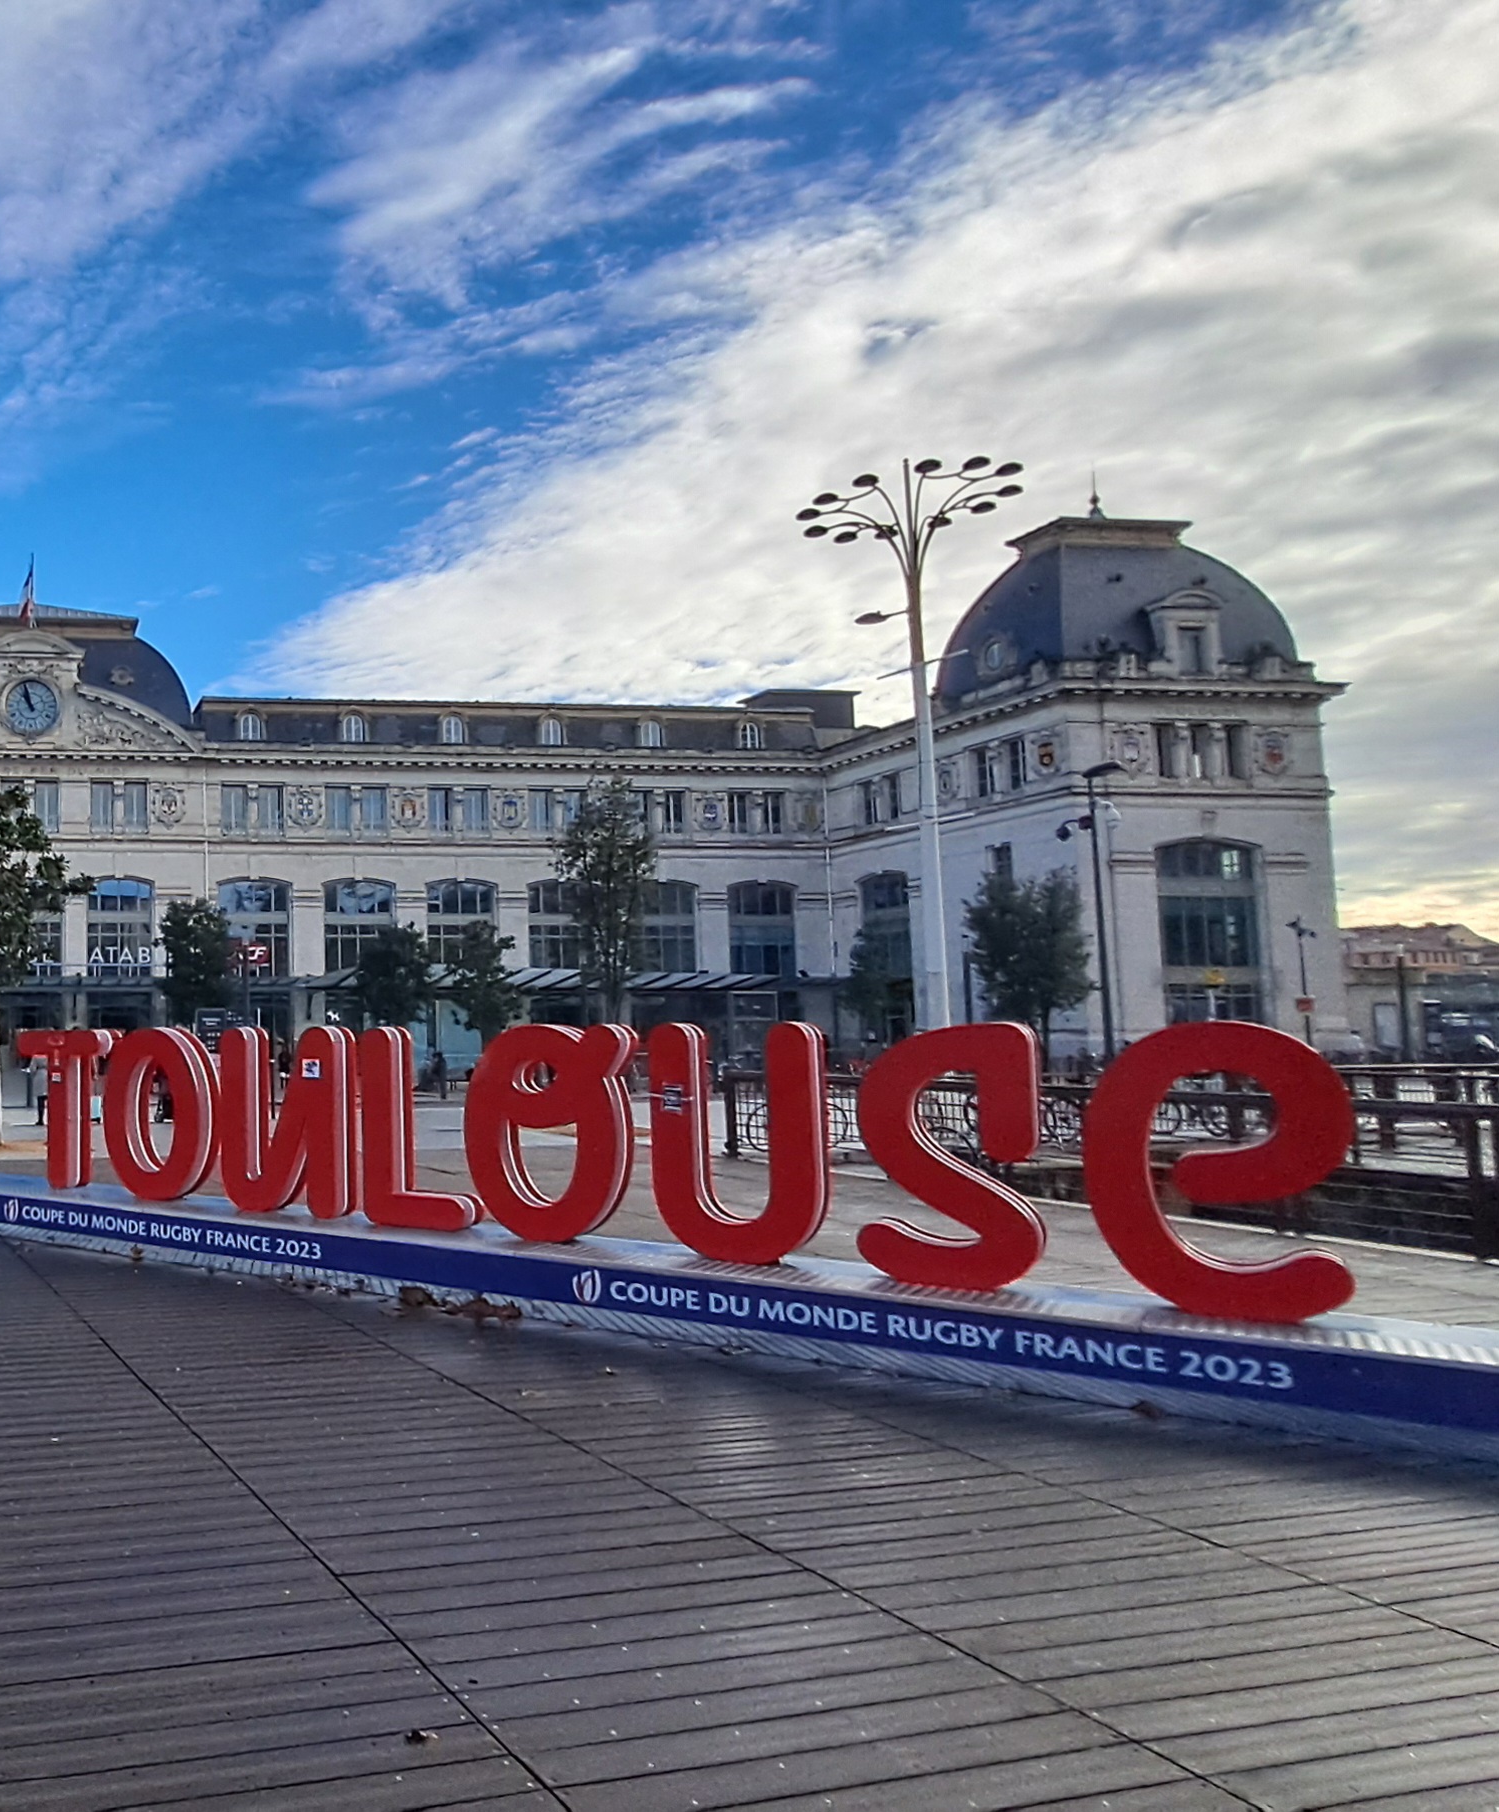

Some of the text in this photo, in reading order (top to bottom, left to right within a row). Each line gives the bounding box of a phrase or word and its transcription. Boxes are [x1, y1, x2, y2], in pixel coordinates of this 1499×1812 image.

[89, 946, 151, 964] ATAB
[21, 1205, 322, 1260] COUPE DU MONDE RUGBY FRANCE 2023
[609, 1280, 1294, 1390] COUPE DU MONDE RUGBY FRANCE 2023
